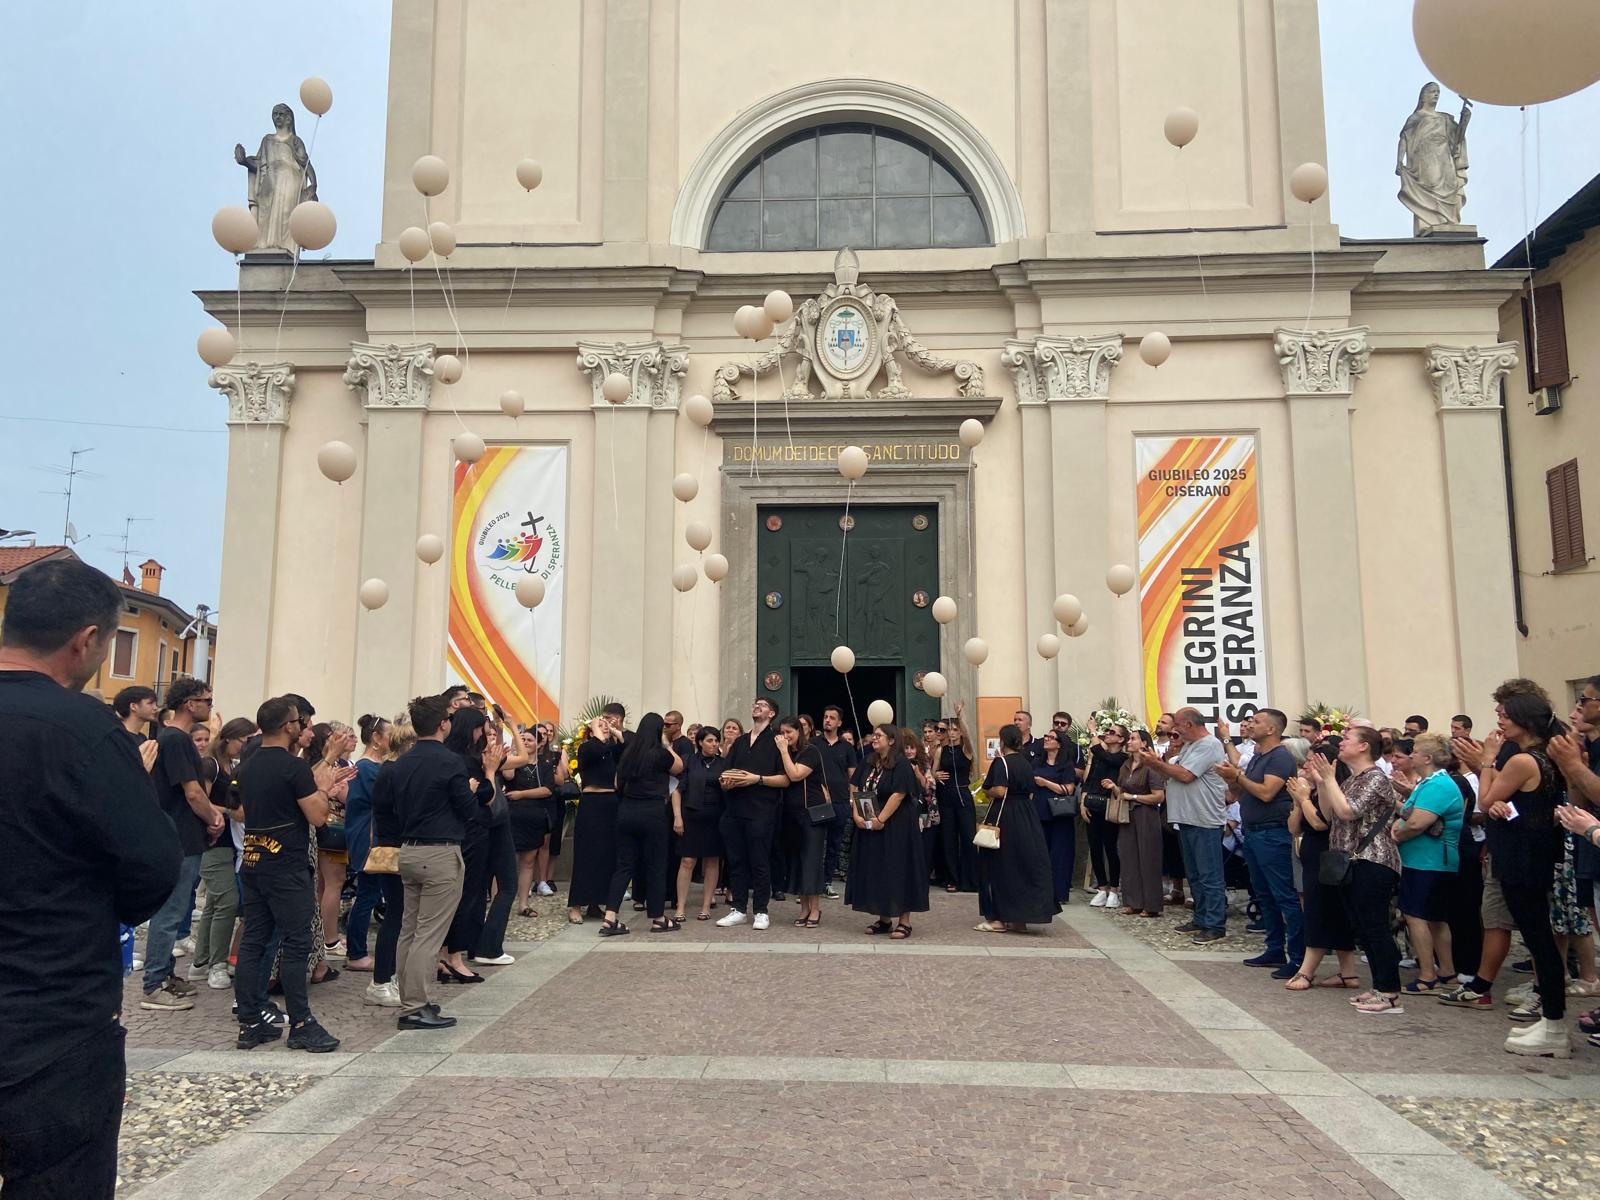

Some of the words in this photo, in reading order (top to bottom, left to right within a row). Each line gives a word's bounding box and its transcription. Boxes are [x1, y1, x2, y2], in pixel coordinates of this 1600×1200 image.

[733, 446, 782, 461] DOMUM
[784, 446, 807, 461] DEI
[862, 444, 960, 460] SANCTITUDO
[1148, 469, 1210, 481] GIUBILEO
[1213, 468, 1247, 481] 2025
[1165, 485, 1231, 497] CISERANO
[478, 519, 497, 546] GIUBILEO
[495, 511, 510, 522] 2025
[545, 523, 561, 571] SPERANZA
[540, 569, 552, 580] DI
[1217, 540, 1260, 724] SPERANZA
